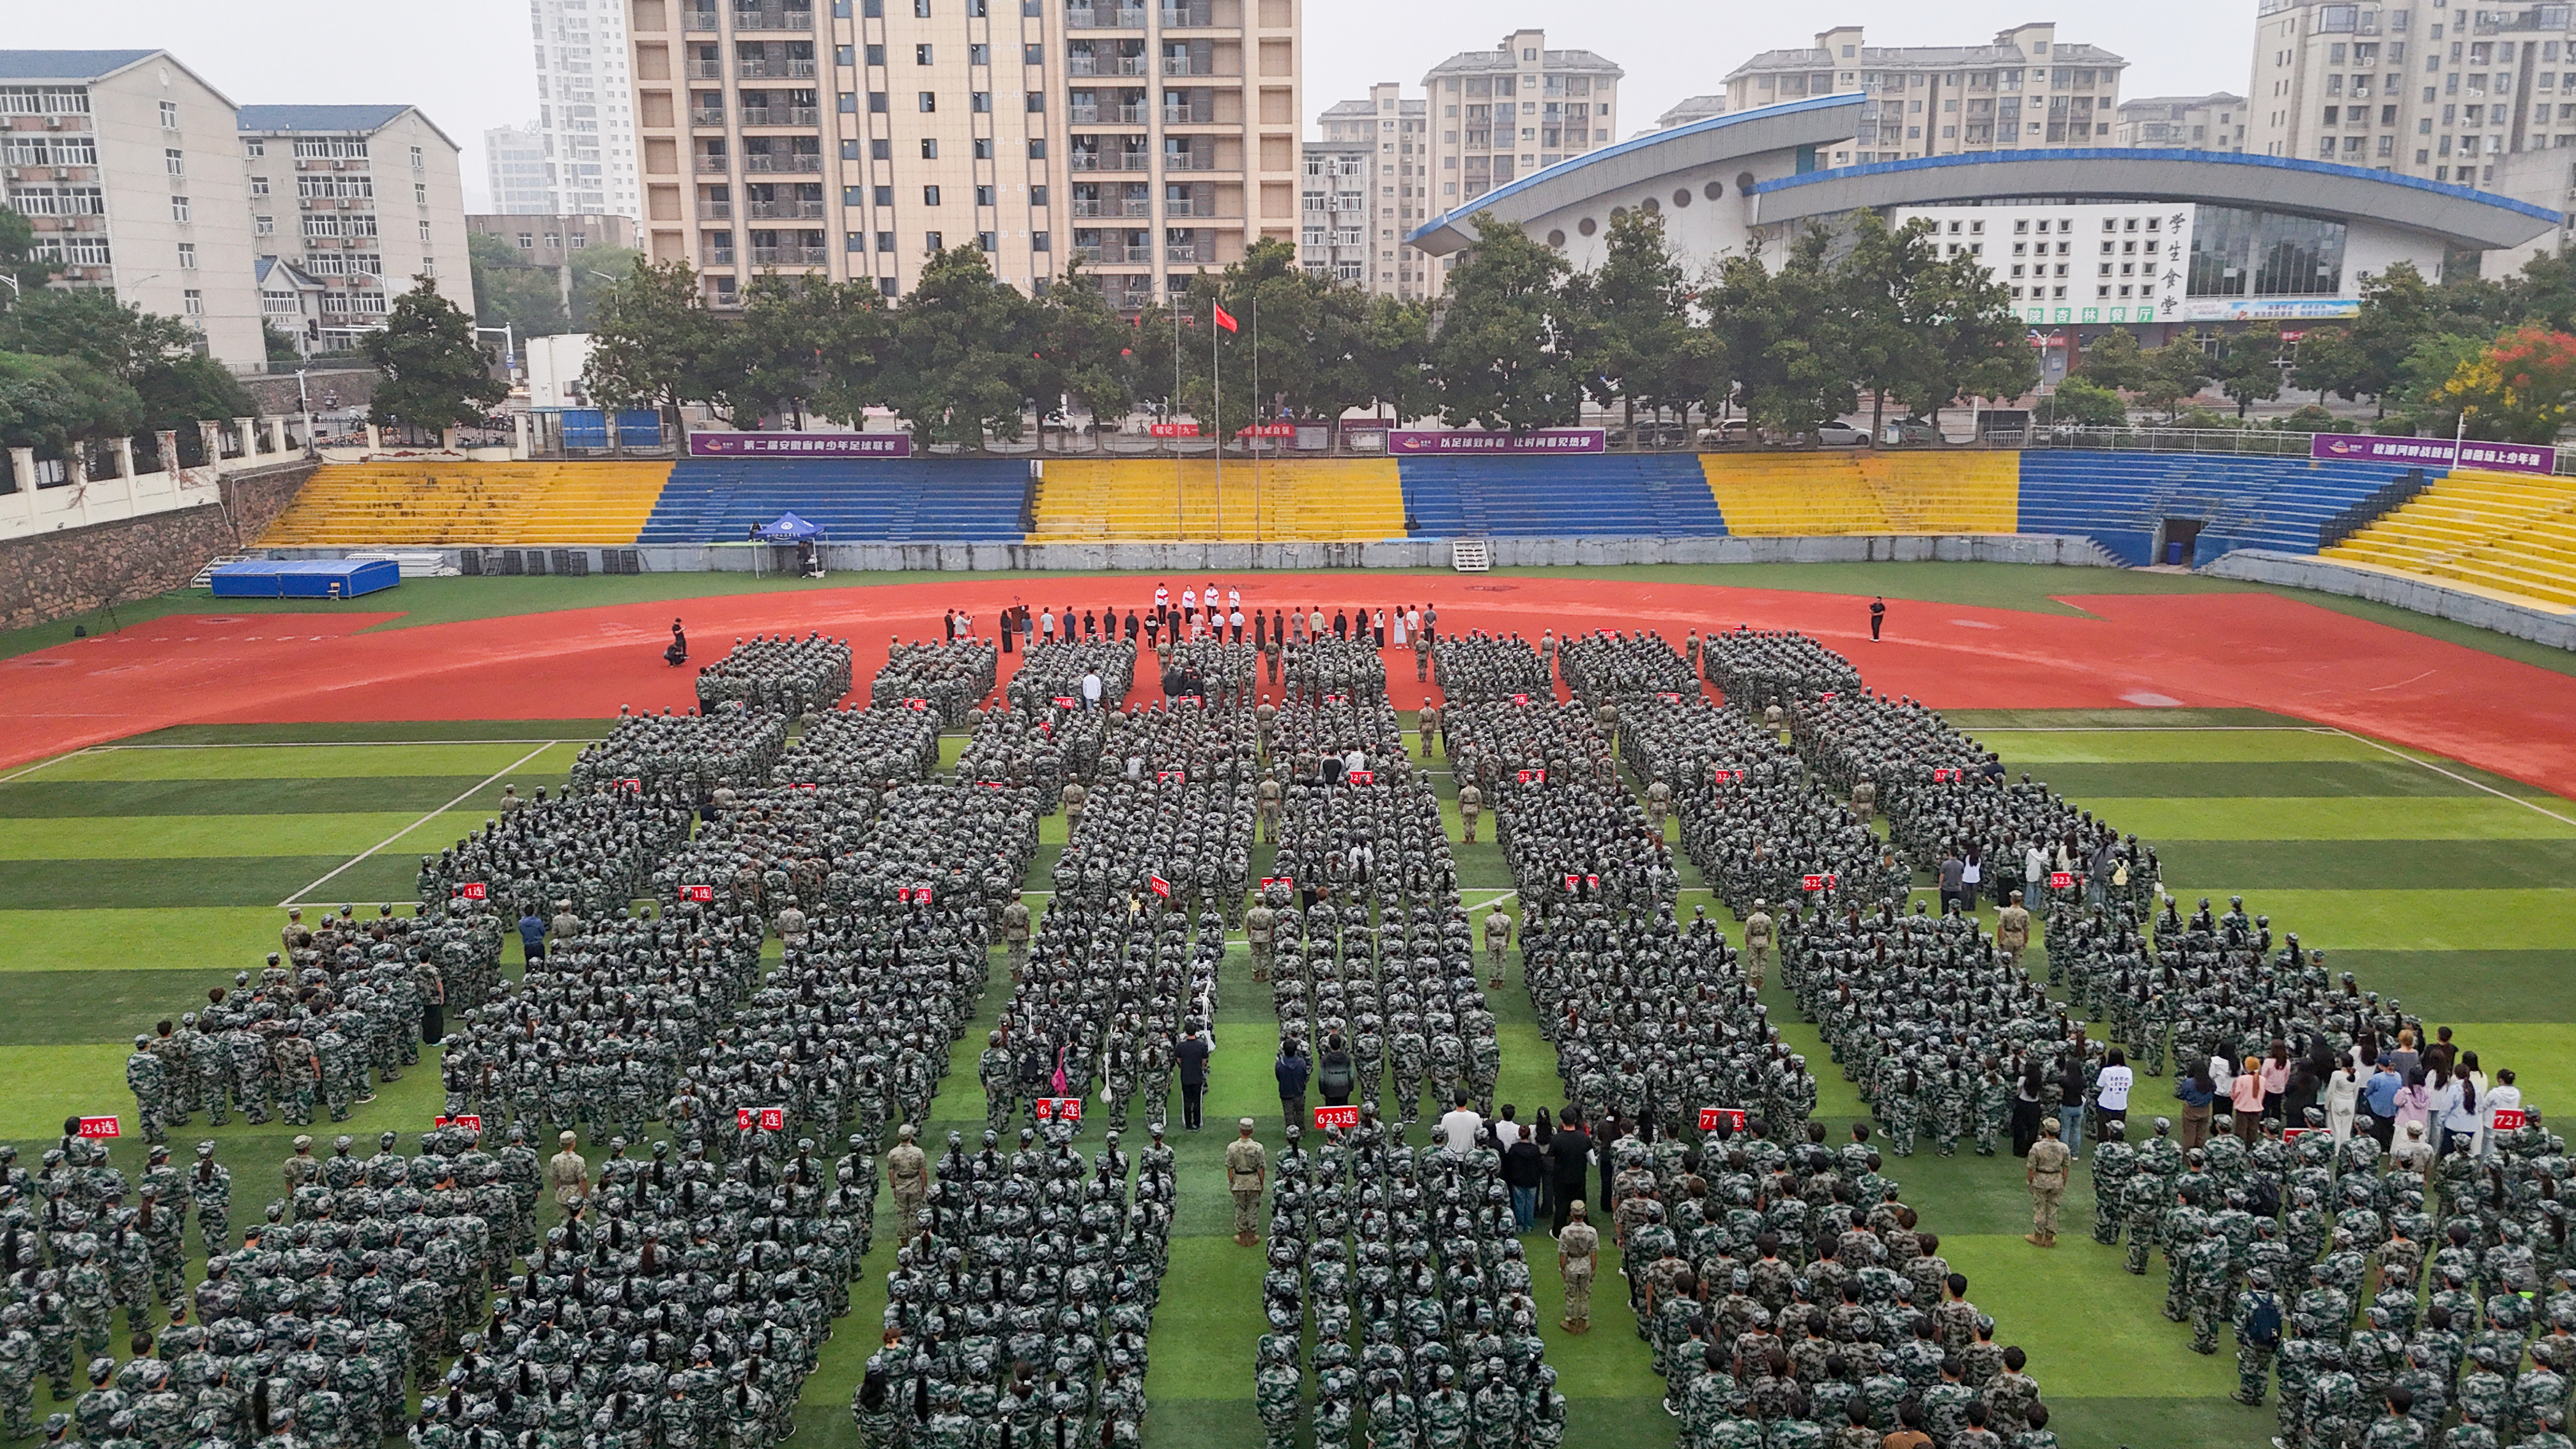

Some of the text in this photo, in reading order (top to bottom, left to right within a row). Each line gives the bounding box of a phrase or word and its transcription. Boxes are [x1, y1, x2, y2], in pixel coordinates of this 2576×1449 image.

[2161, 212, 2186, 315] 学生食堂
[744, 440, 895, 450] 第二届安徽省青少年足球联赛
[1440, 438, 1505, 448] 以足球致青春
[1514, 436, 1591, 447] 让时间看见热爱
[1317, 1110, 1358, 1124] 623连
[1702, 1114, 1742, 1128] 71连
[2495, 1115, 2524, 1126] 721
